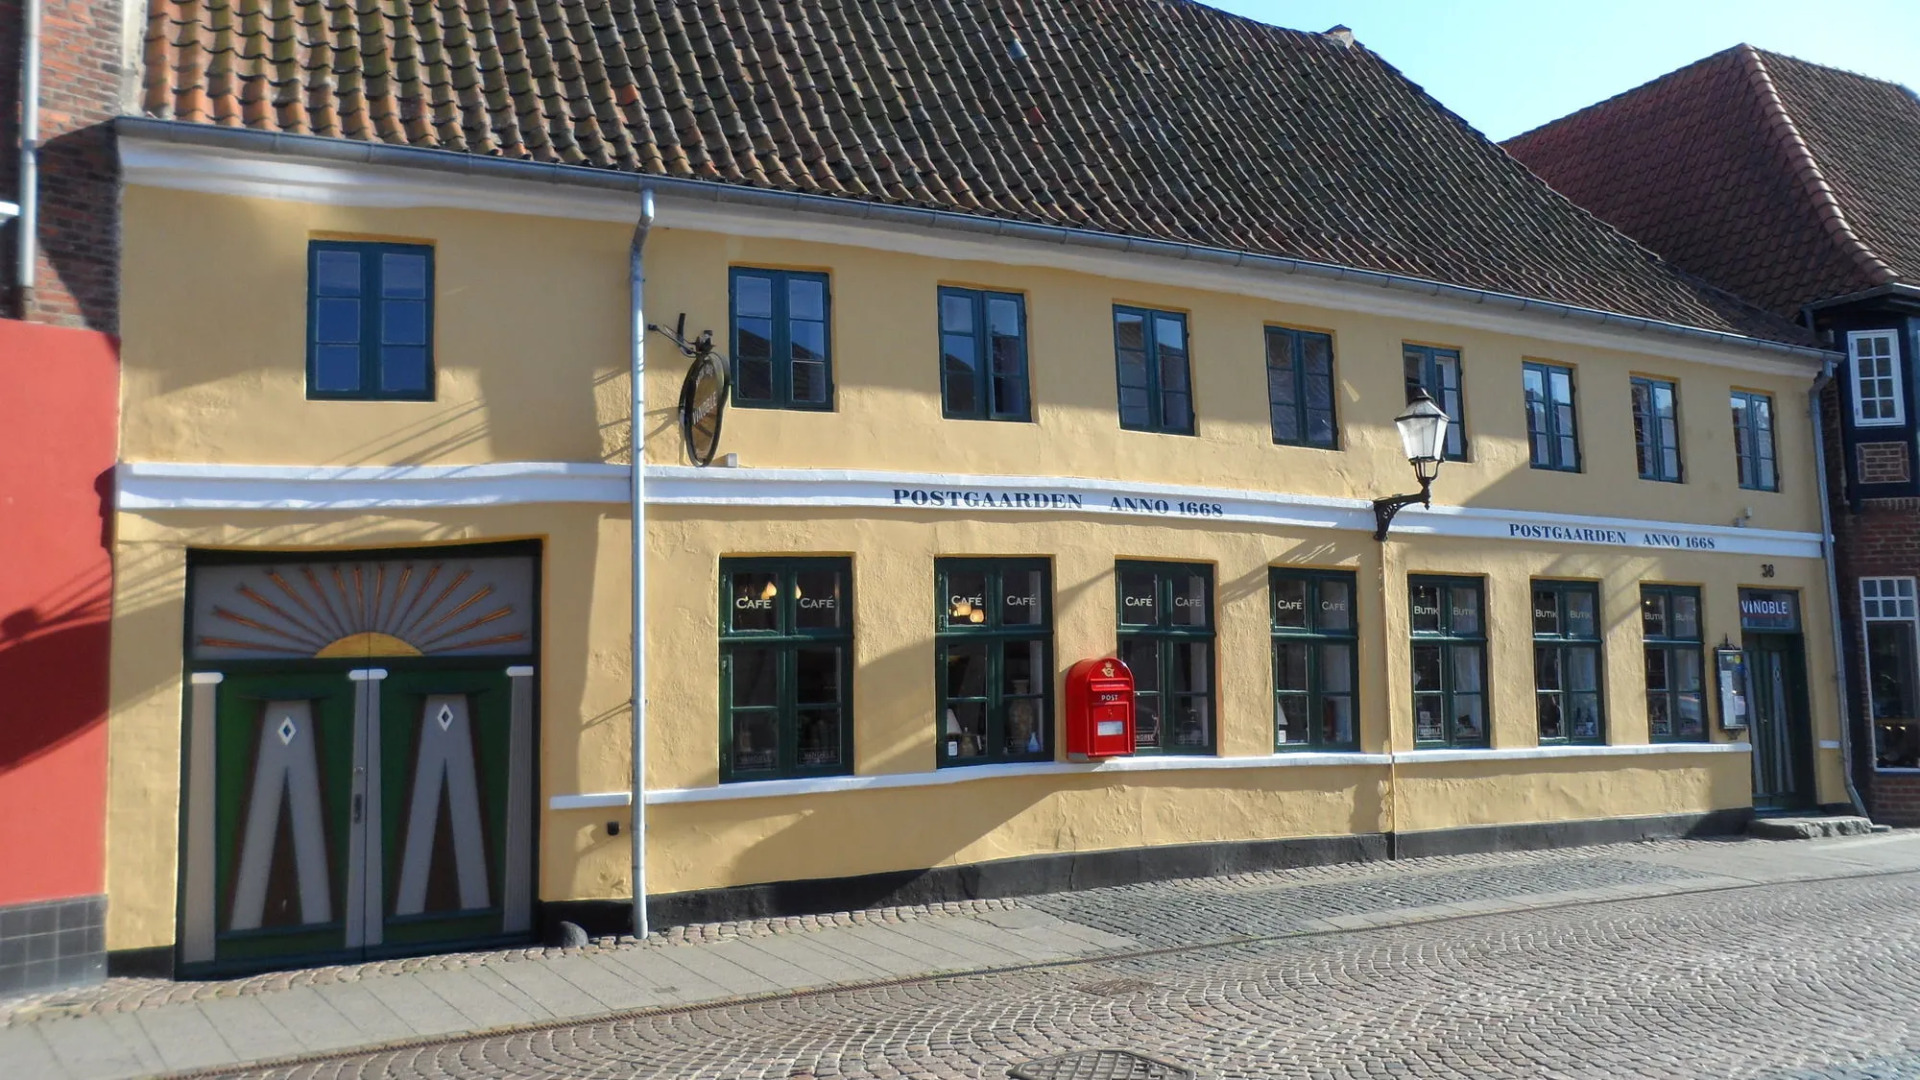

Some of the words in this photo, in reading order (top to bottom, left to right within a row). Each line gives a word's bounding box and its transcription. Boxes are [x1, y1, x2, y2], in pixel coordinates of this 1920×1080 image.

[892, 488, 1084, 510] POSTGAARDEN
[1109, 495, 1170, 515] ANNO
[1177, 501, 1225, 518] 1668
[1509, 523, 1627, 545] POSTGAARDEN
[1643, 533, 1681, 548] ANNO
[1685, 536, 1716, 550] 1668
[1741, 600, 1789, 615] VINOBLE
